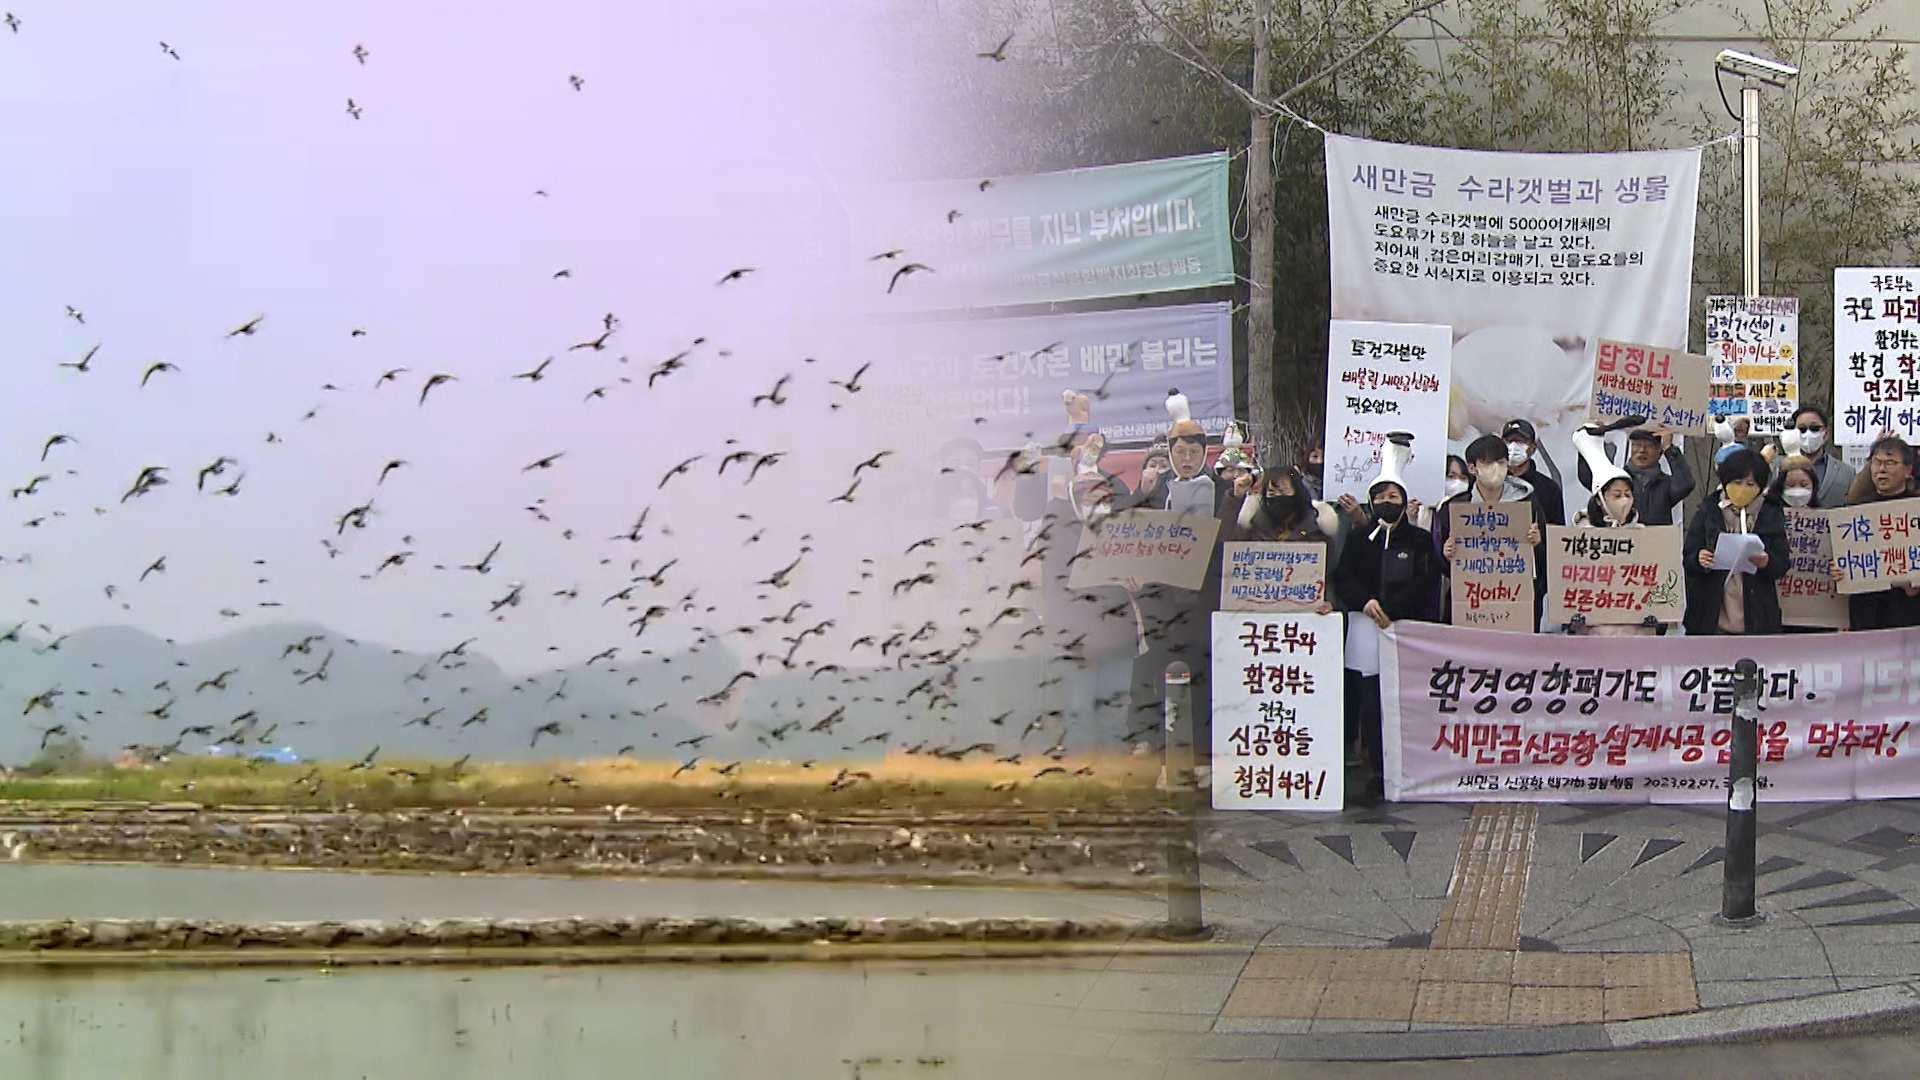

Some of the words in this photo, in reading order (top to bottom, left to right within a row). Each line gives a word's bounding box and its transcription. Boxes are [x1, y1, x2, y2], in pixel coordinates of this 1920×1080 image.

[1351, 164, 1437, 199] 새만금
[1457, 175, 1603, 204] 수라갯벌과
[1614, 174, 1669, 202] 생물
[1040, 211, 1082, 246] 지닌
[1089, 197, 1202, 242] 부처입니다.
[1374, 205, 1420, 224] 새만금
[1559, 235, 1595, 250] 있다.
[1424, 265, 1486, 283] 서식지로
[1559, 271, 1595, 287] 있다.
[1870, 275, 1914, 293] 국토부는
[1844, 296, 1876, 323] 국토
[1874, 330, 1919, 350] 환경부는
[1080, 342, 1132, 374] 배만
[1141, 335, 1218, 371] 불리는
[1597, 343, 1674, 380] 답정너.
[1849, 351, 1884, 378] 환경
[1897, 352, 1920, 379] 착
[1749, 381, 1788, 399] 새만금
[1837, 514, 1874, 542] 기후
[1561, 531, 1635, 560] 기후붕괴다
[1561, 563, 1617, 586] 마지막
[1620, 563, 1658, 588] 갯벌
[1837, 549, 1880, 580] 마지막
[1563, 587, 1651, 612] 보존하라!
[1238, 621, 1317, 656] 국토부와
[1242, 661, 1315, 695] 환경부는
[1428, 659, 1657, 715] 환경영향평가도
[1258, 699, 1296, 724] 전국의
[1228, 723, 1314, 757] 신공항들
[1710, 720, 1790, 764] 입을
[1807, 719, 1911, 759] 멈추라!
[1457, 774, 1499, 791] 새만금
